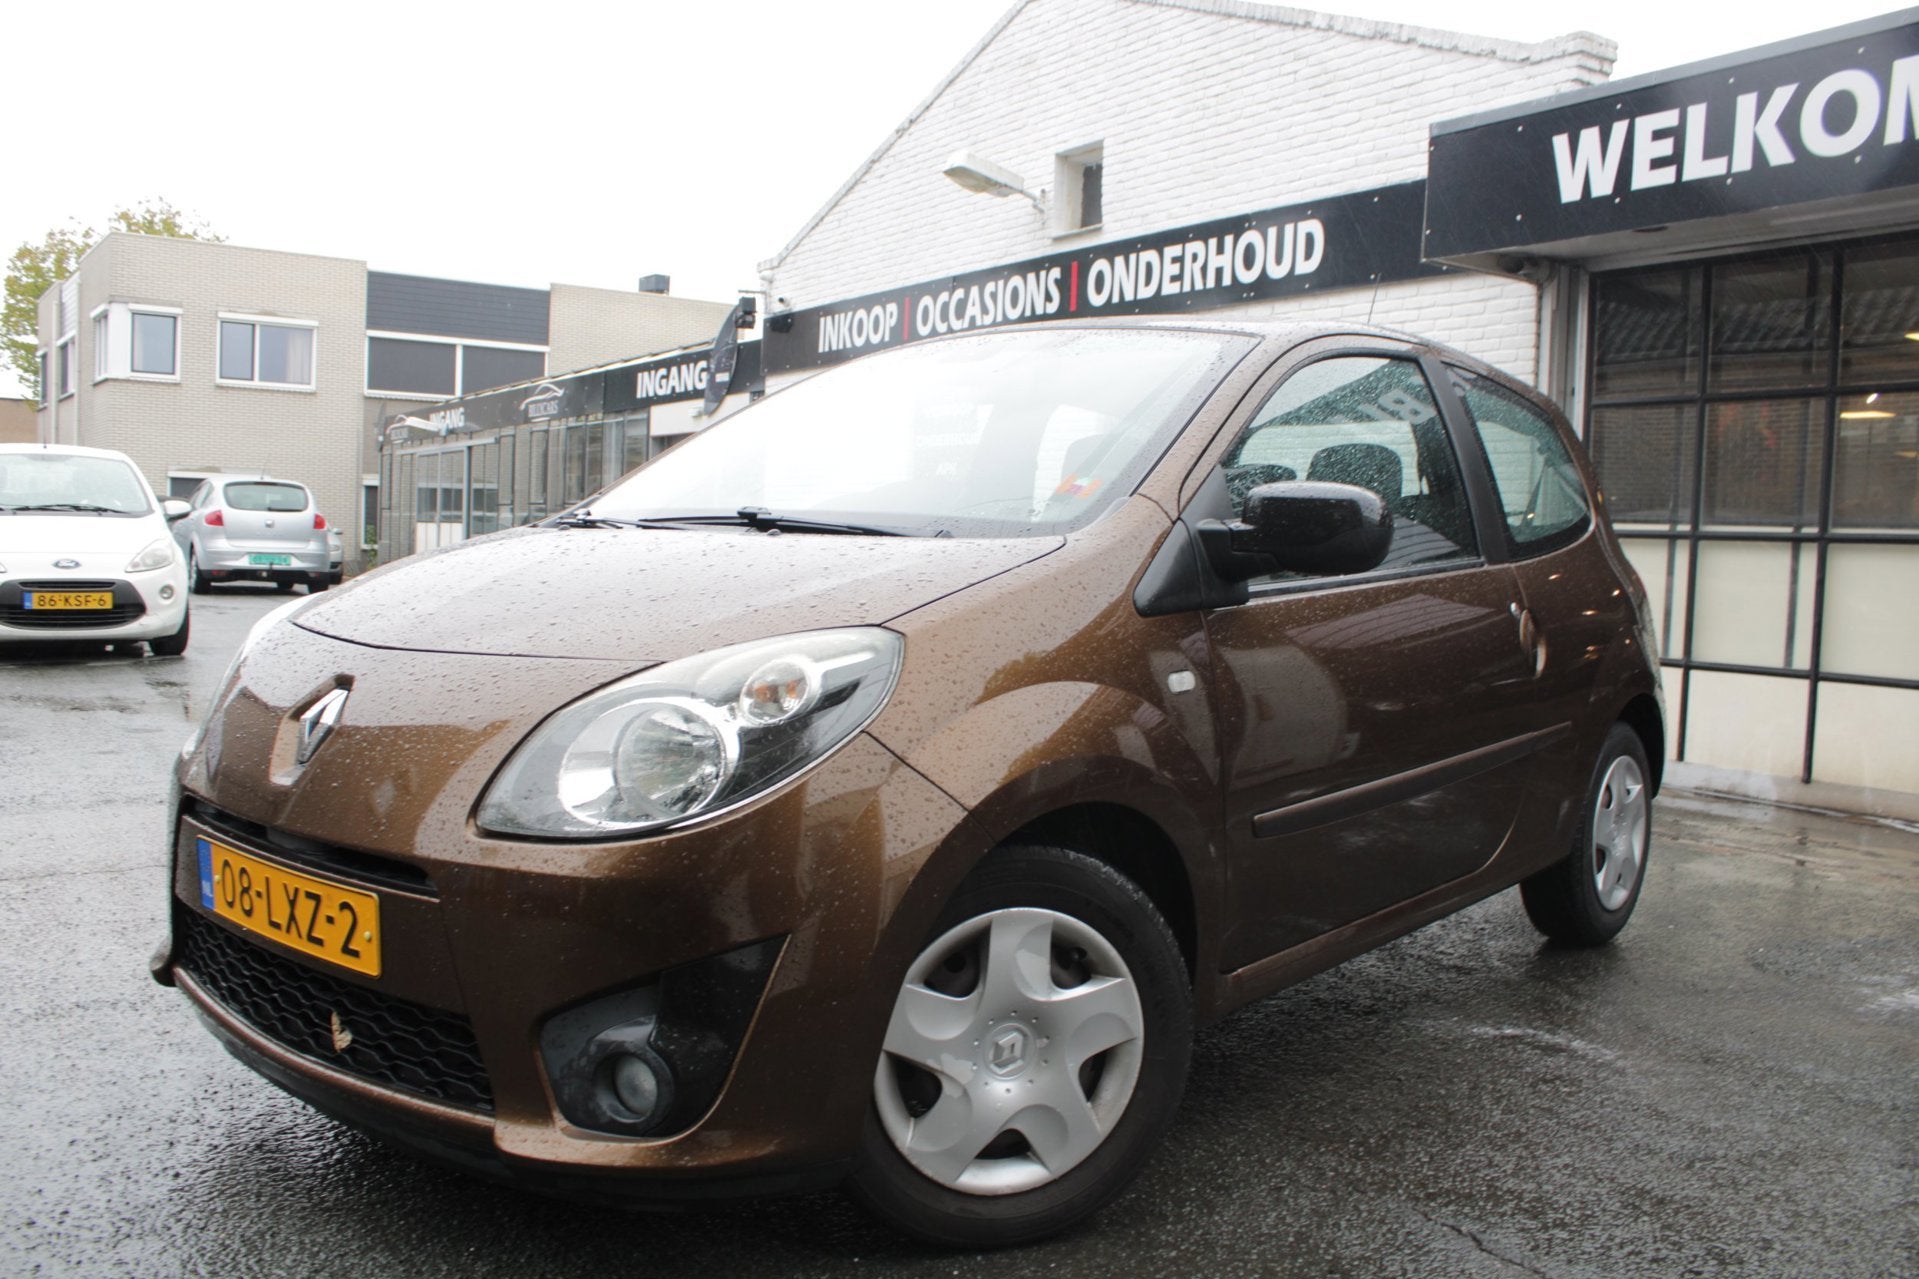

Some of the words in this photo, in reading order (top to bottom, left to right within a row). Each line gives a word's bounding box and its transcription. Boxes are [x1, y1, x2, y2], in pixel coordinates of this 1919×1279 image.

[818, 301, 898, 353] INKOOP
[915, 266, 1062, 337] OCCASIONS
[1087, 217, 1326, 308] ONDERHOUD
[636, 360, 708, 399] INGANG
[37, 594, 107, 607] 86-KSF-6
[221, 858, 361, 959] 08-LXZ-2
